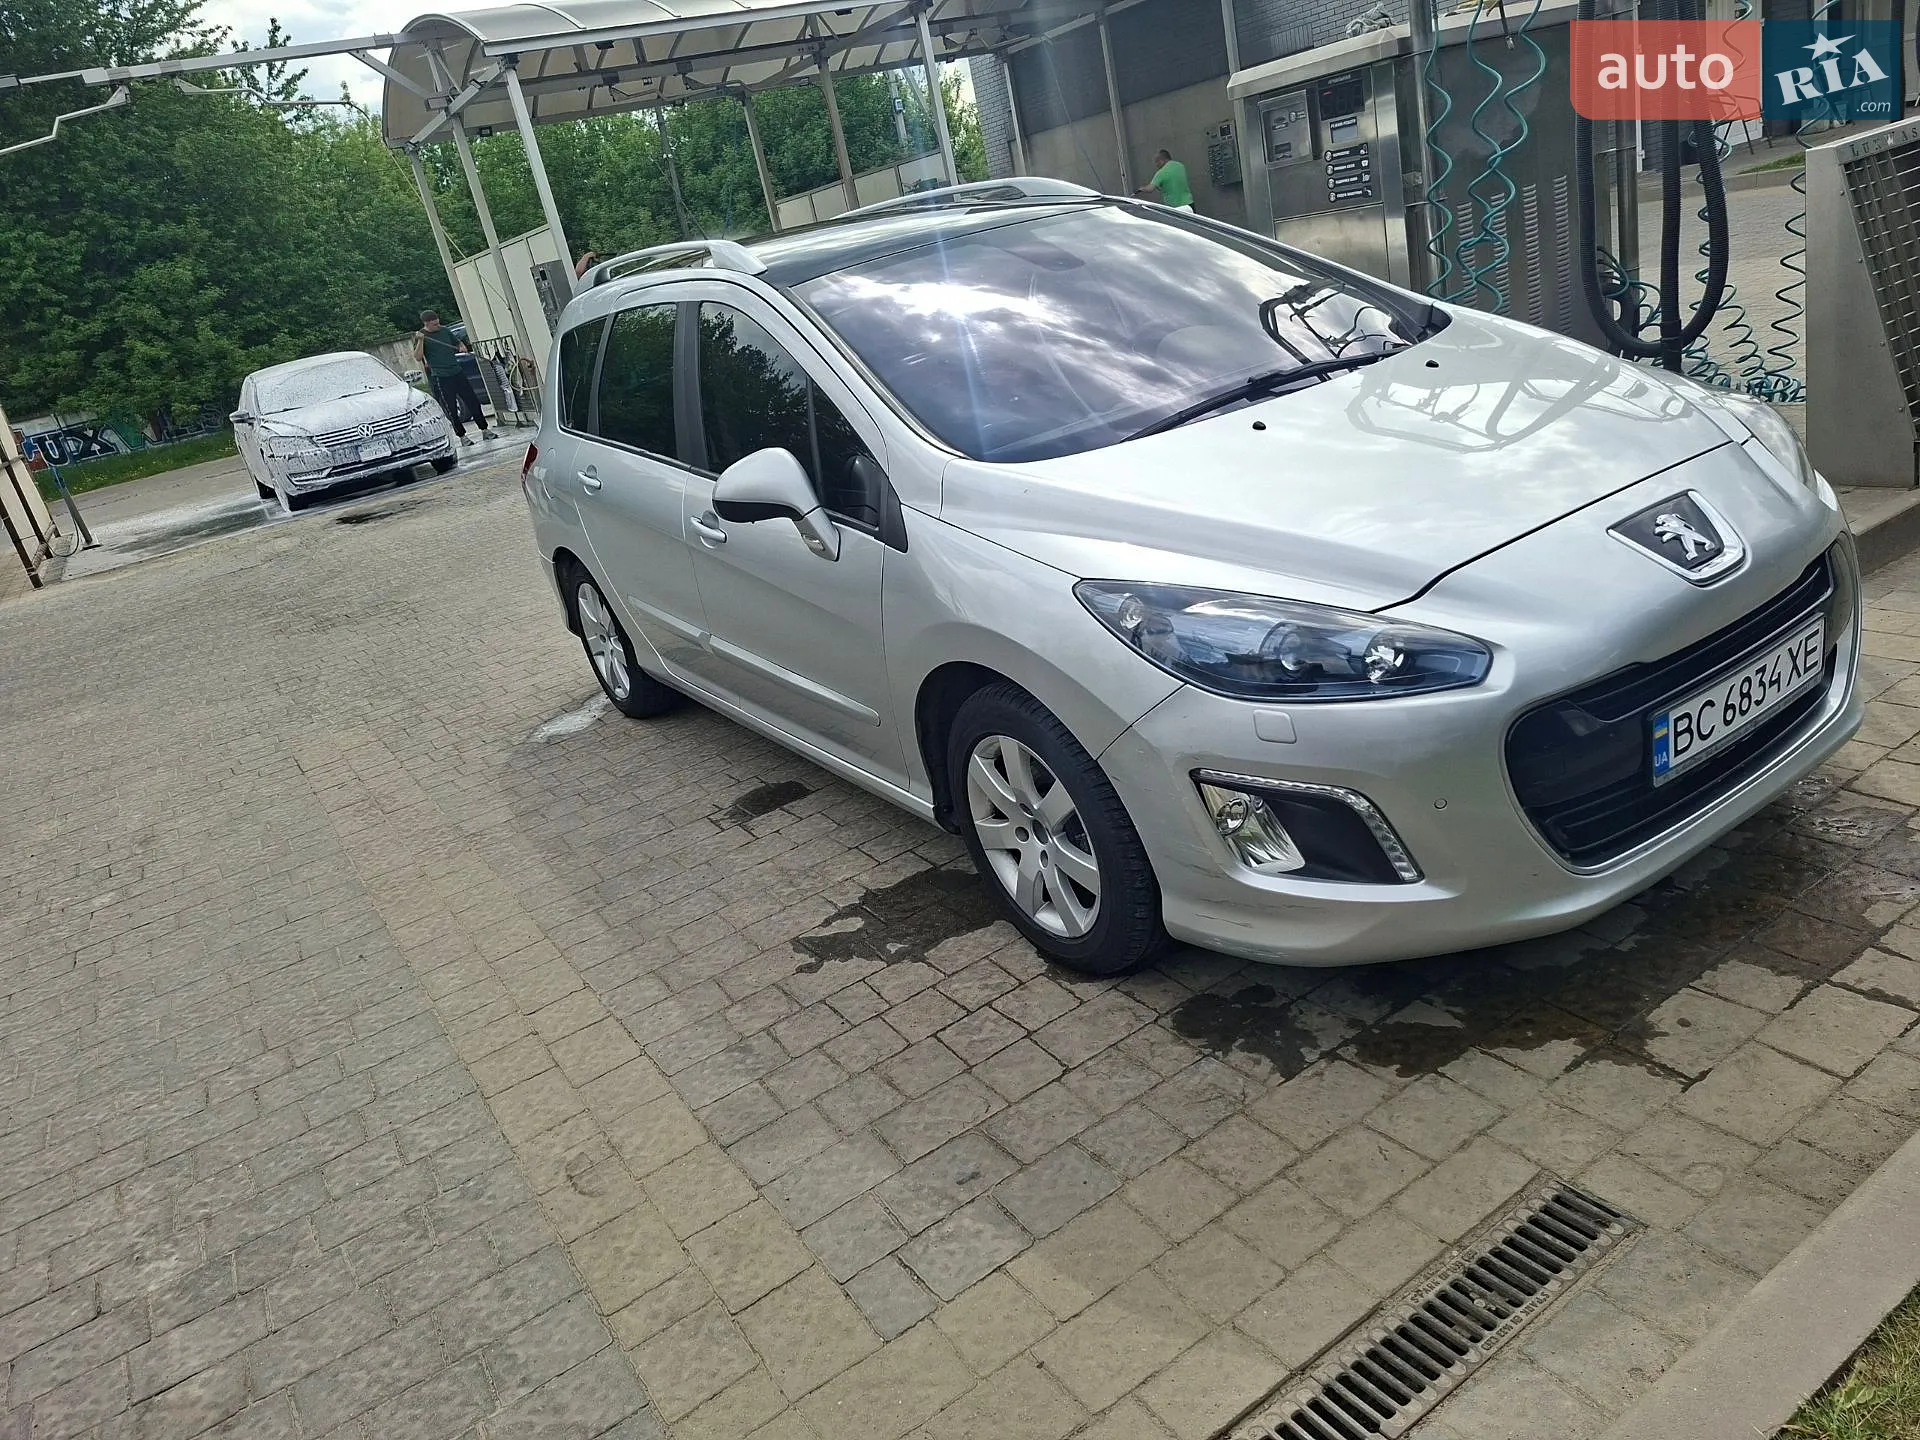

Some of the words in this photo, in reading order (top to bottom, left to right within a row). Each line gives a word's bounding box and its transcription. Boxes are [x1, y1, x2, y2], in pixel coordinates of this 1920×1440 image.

[1674, 699, 1715, 758] BC
[1723, 655, 1781, 726] 6834
[1787, 628, 1819, 687] XE
[1655, 752, 1668, 767] UA
